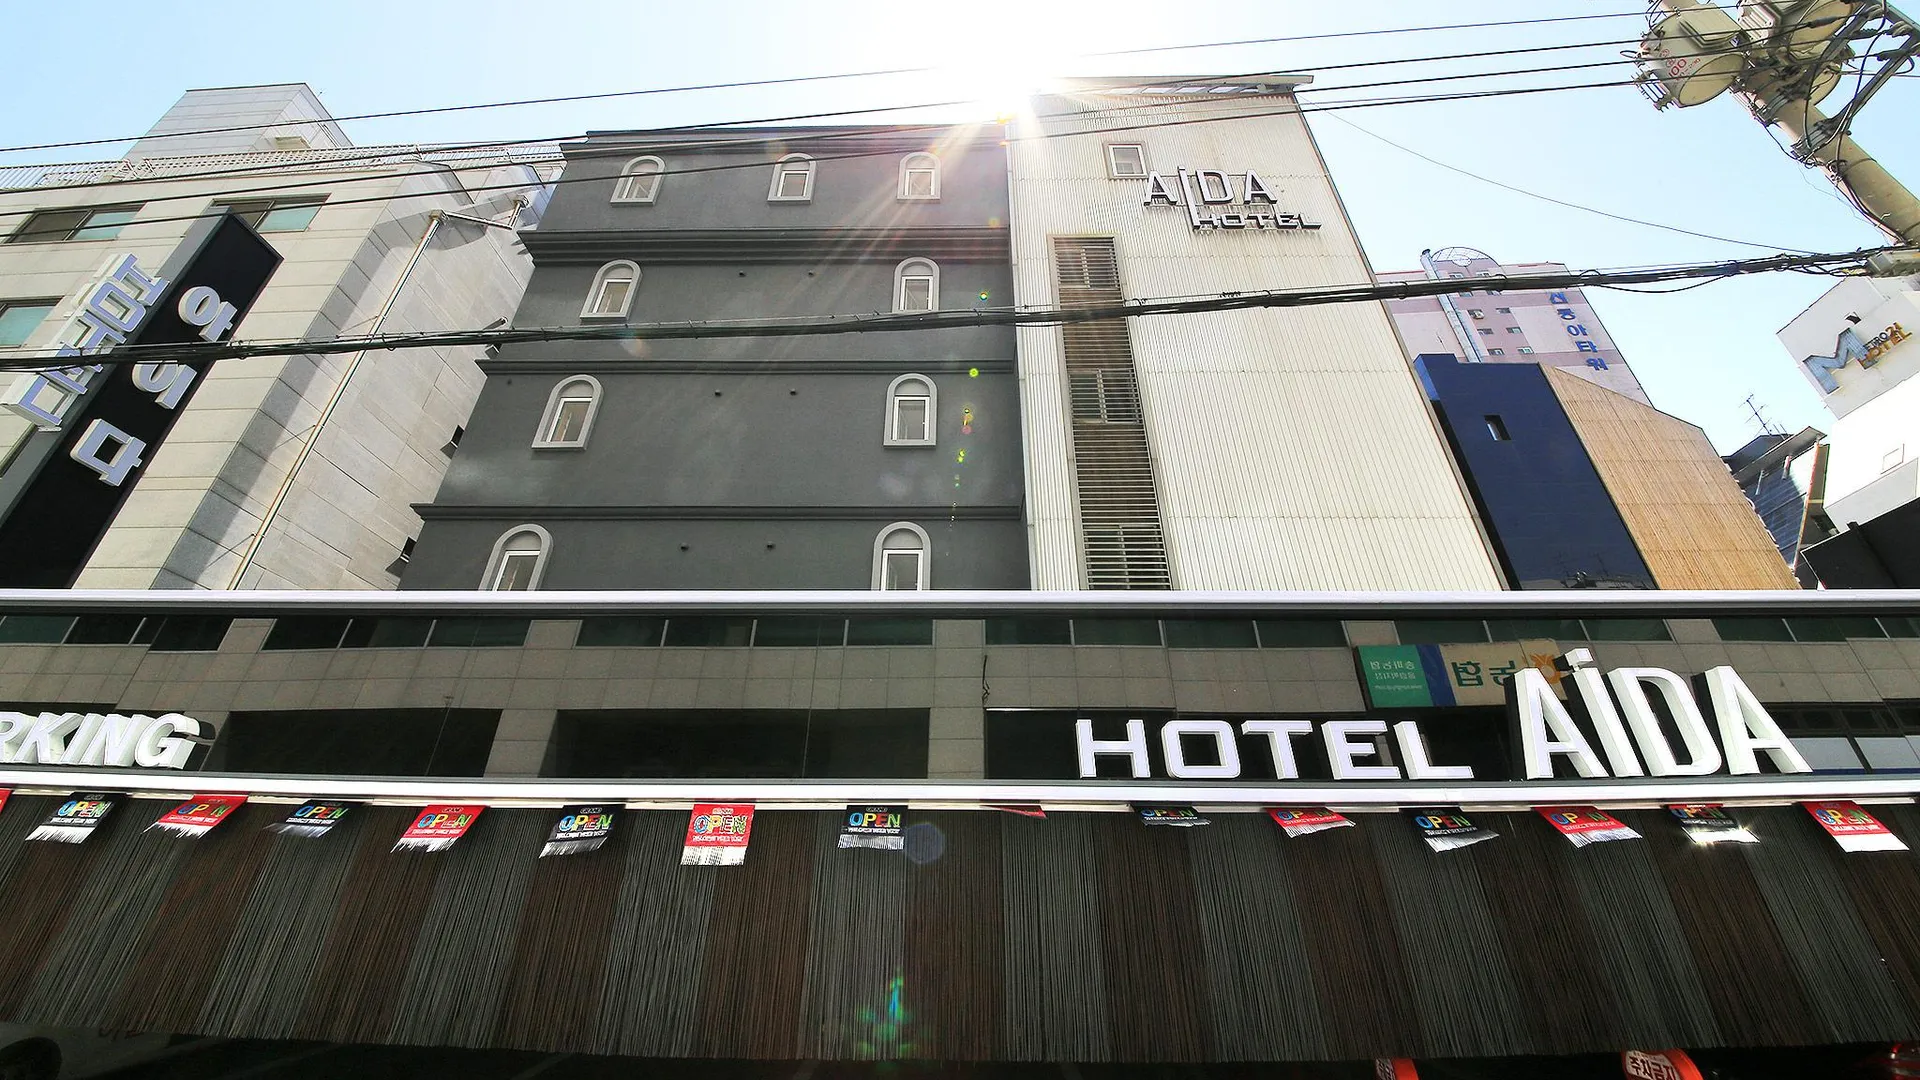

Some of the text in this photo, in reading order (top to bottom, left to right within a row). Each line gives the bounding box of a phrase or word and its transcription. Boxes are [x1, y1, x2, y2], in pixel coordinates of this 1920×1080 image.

[1193, 211, 1322, 230] HOTEL
[1074, 717, 1475, 781] HOTEL
[58, 800, 114, 817] OPEN
[177, 803, 232, 818] OPN
[295, 805, 350, 819] OPEN
[1277, 809, 1332, 820] OPN
[559, 814, 614, 832] OPEN
[693, 814, 748, 834] OPEN
[849, 812, 901, 828] OPEN
[1415, 815, 1472, 829] OPEN
[1550, 811, 1608, 825] OPN
